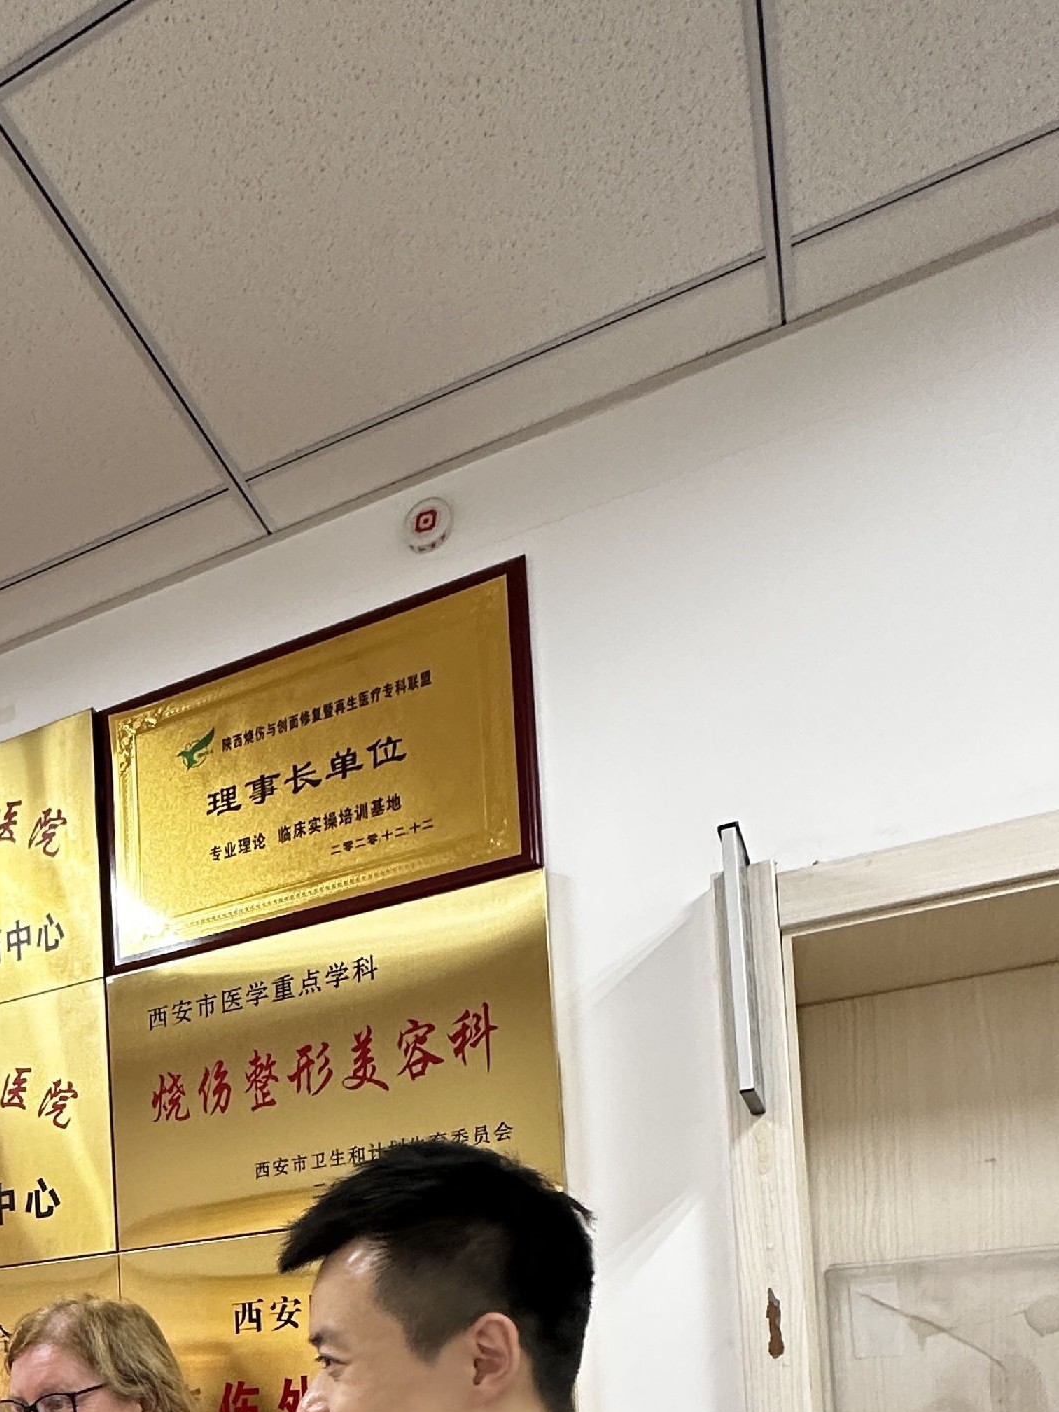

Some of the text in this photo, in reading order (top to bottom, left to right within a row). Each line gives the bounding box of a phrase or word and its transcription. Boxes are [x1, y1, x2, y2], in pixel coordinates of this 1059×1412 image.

[206, 736, 408, 817] 理事长单位
[209, 792, 403, 861] 专业理论 临床实操培训基地
[147, 954, 379, 1032] 西安市医学重点学科
[151, 1002, 499, 1123] 烧伤整形美容科
[232, 1294, 312, 1335] 西安
